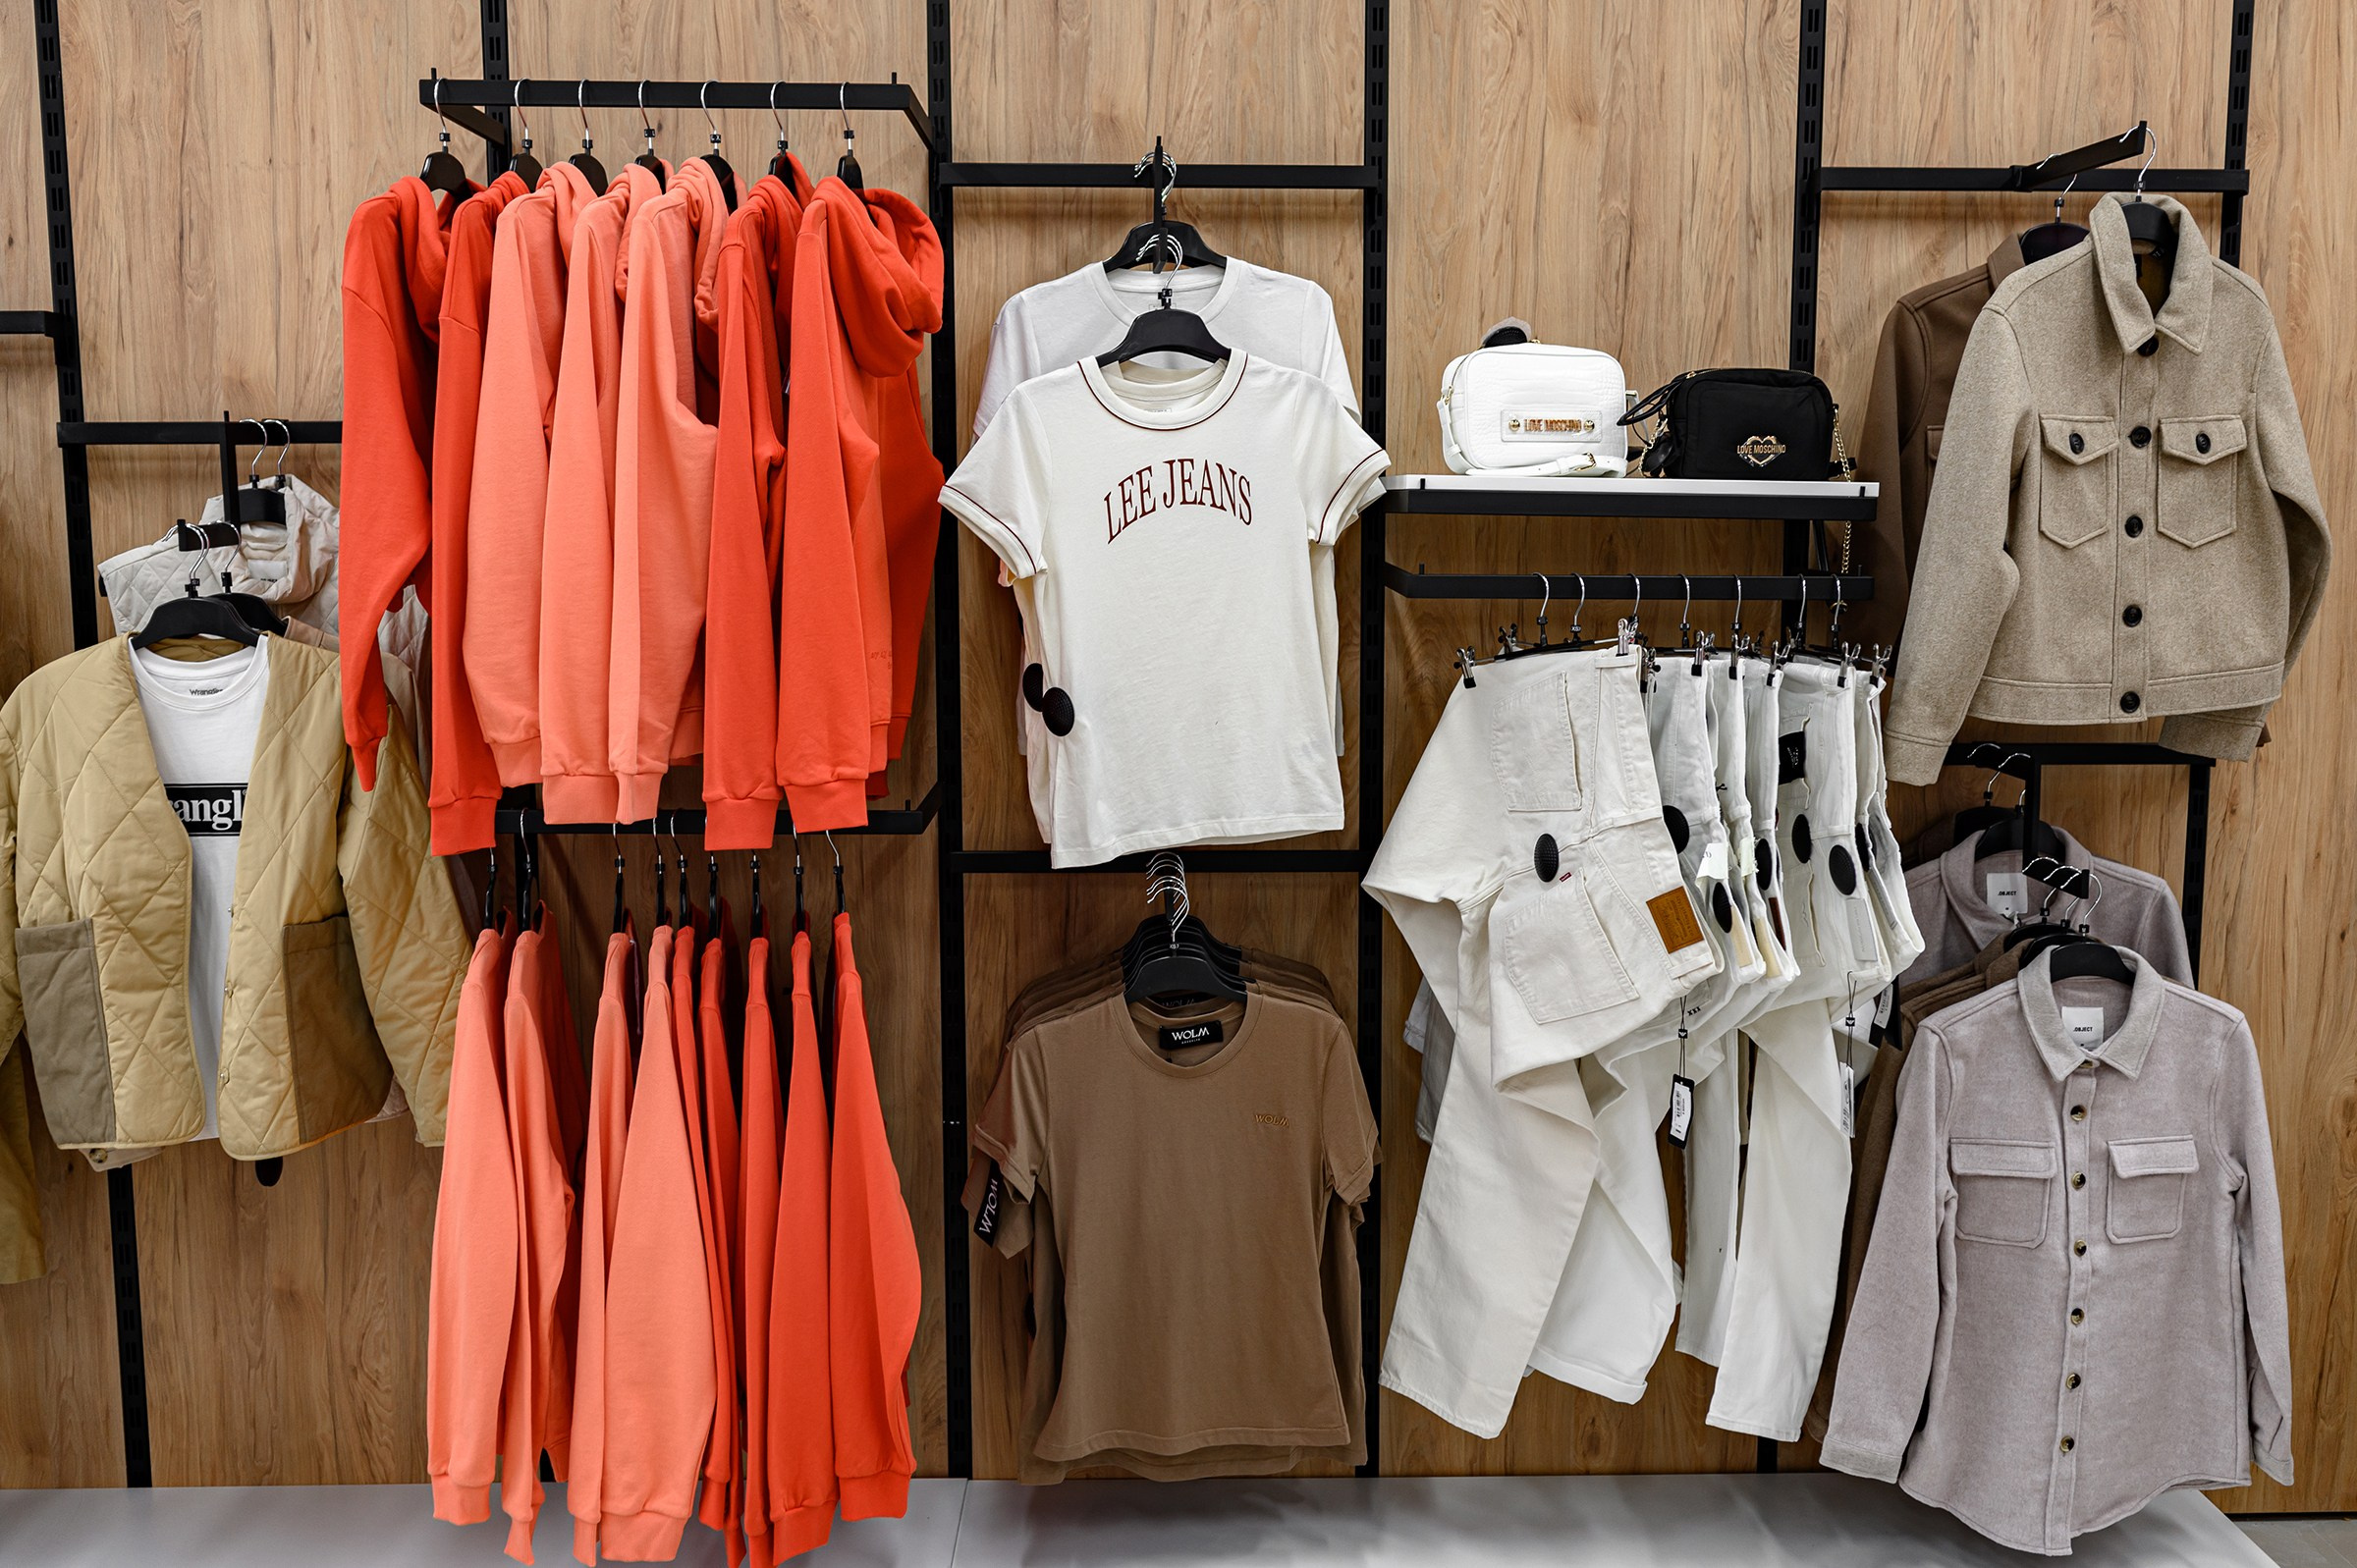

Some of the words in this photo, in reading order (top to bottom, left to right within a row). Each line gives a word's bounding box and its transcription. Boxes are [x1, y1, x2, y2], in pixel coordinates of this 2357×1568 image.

[1524, 418, 1543, 432] LOVE
[1545, 419, 1582, 433] MOSCHINO
[1737, 445, 1752, 454] LOVE
[1753, 445, 1786, 454] MOSCHINO
[1103, 465, 1156, 545] LEE
[1162, 459, 1252, 525] JEANS
[169, 789, 243, 831] angl
[1172, 1027, 1209, 1041] WOLM
[1255, 1114, 1290, 1128] WOLM
[978, 1178, 998, 1233] WOLM
